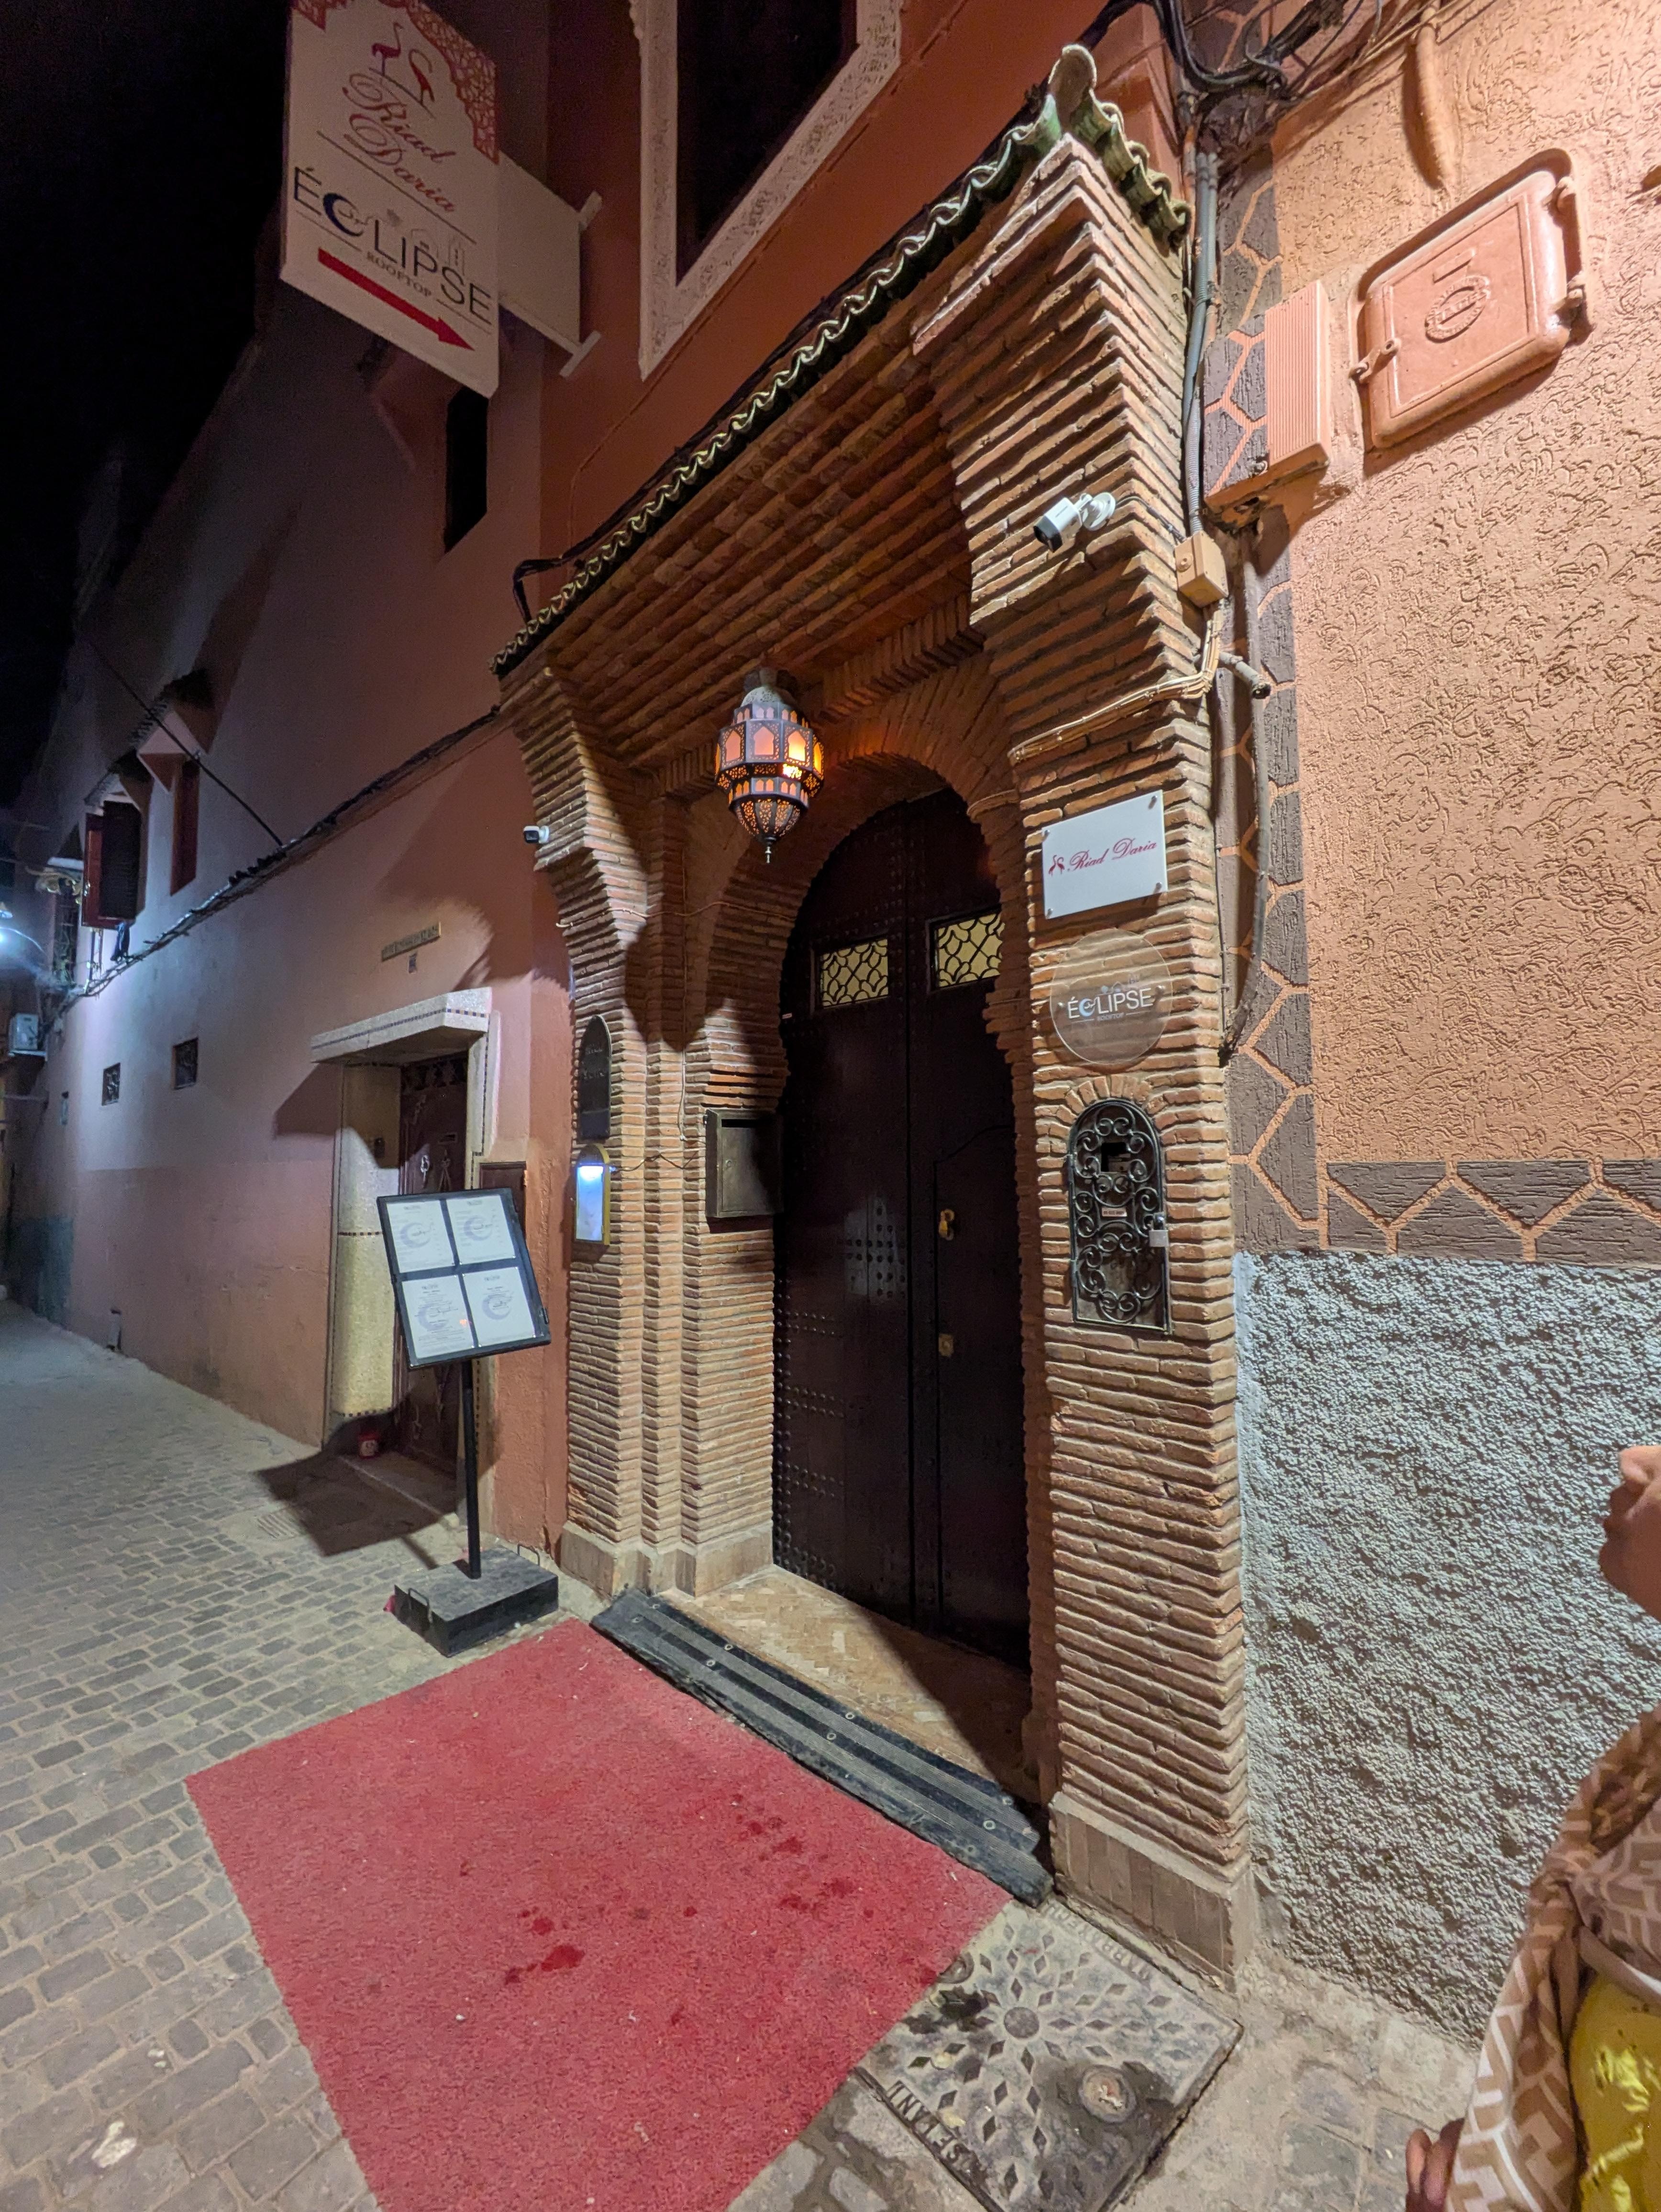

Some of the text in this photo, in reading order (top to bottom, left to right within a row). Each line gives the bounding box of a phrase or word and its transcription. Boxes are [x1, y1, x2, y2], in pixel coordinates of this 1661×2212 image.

[342, 73, 456, 163] Riad
[344, 114, 454, 212] Daria
[294, 166, 492, 325] ÉCLIPSE
[366, 251, 432, 297] ROOFTOP
[1067, 838, 1156, 872] Riad Daria
[1067, 988, 1153, 1019] ÉCLIPSE
